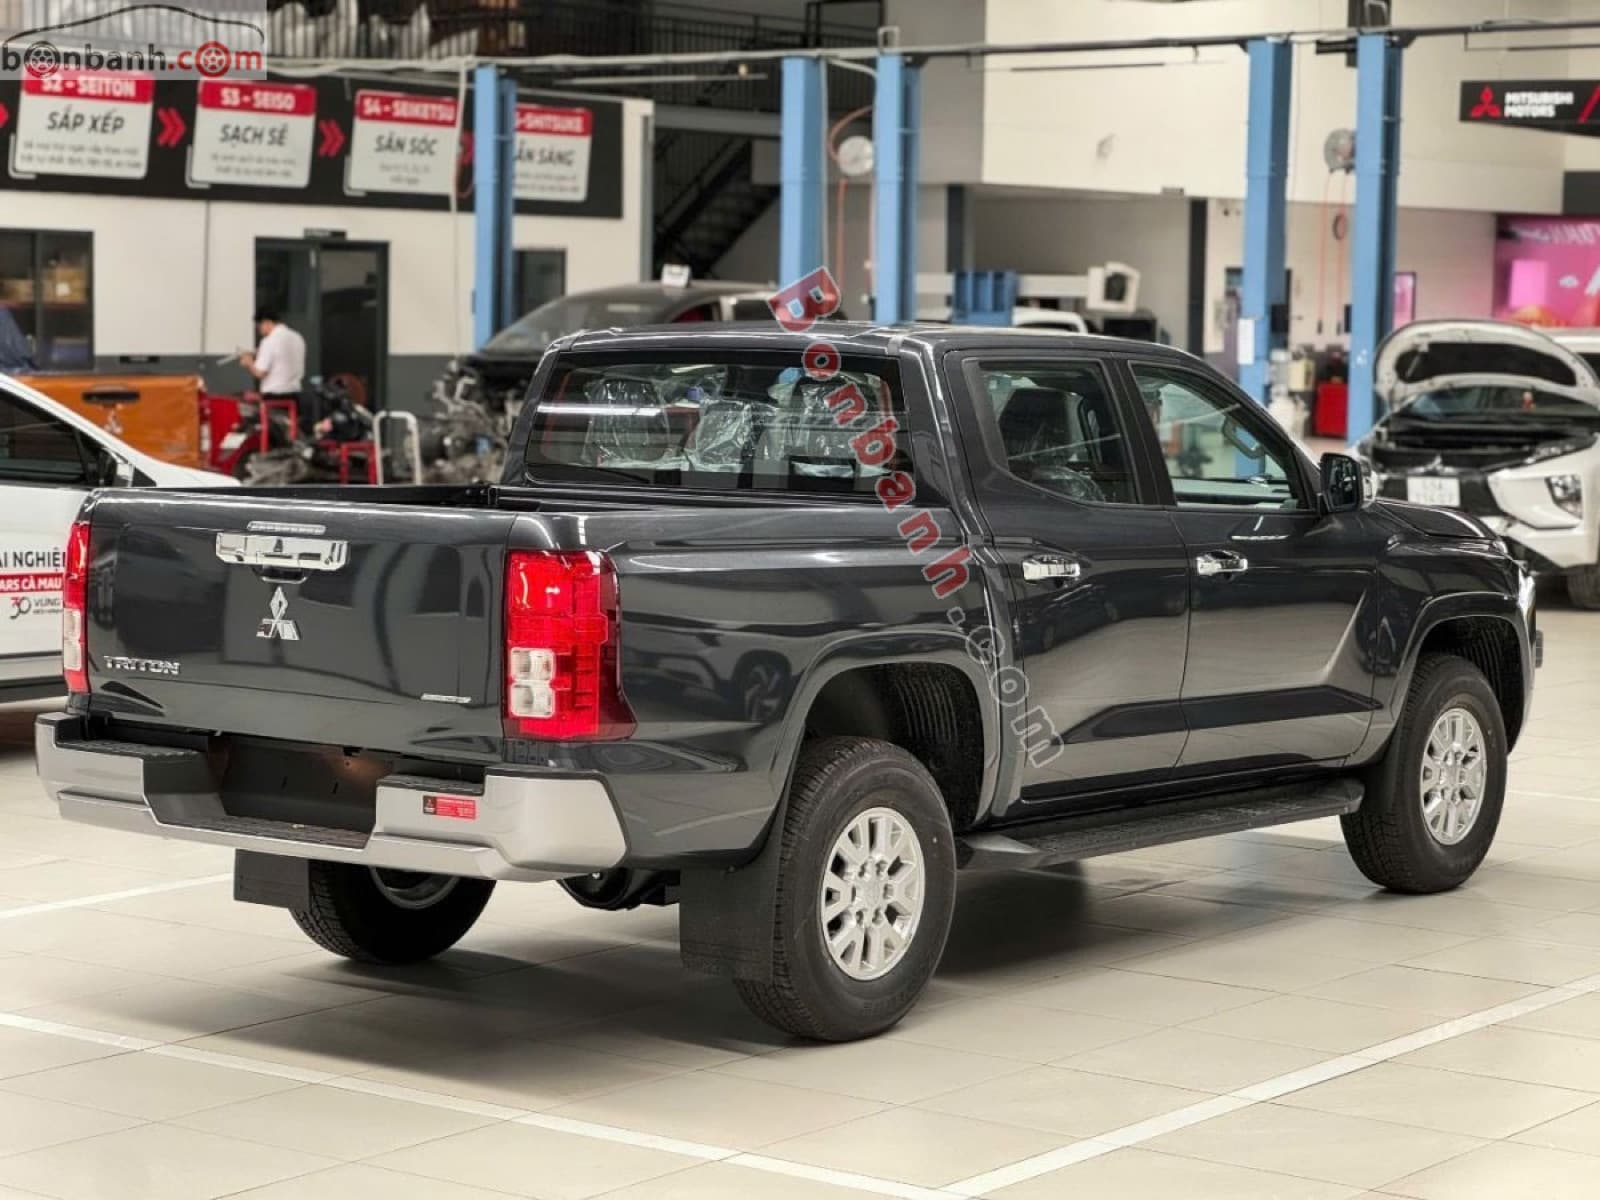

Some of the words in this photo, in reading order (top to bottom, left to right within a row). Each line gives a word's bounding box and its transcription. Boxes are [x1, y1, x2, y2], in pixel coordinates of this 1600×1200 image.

[77, 75, 137, 97] SEITON
[252, 90, 296, 110] SEISO
[1504, 91, 1575, 105] MITSUBISHI
[1503, 104, 1556, 118] MOTORS
[37, 577, 63, 590] MAU
[103, 655, 180, 675] TRITON
